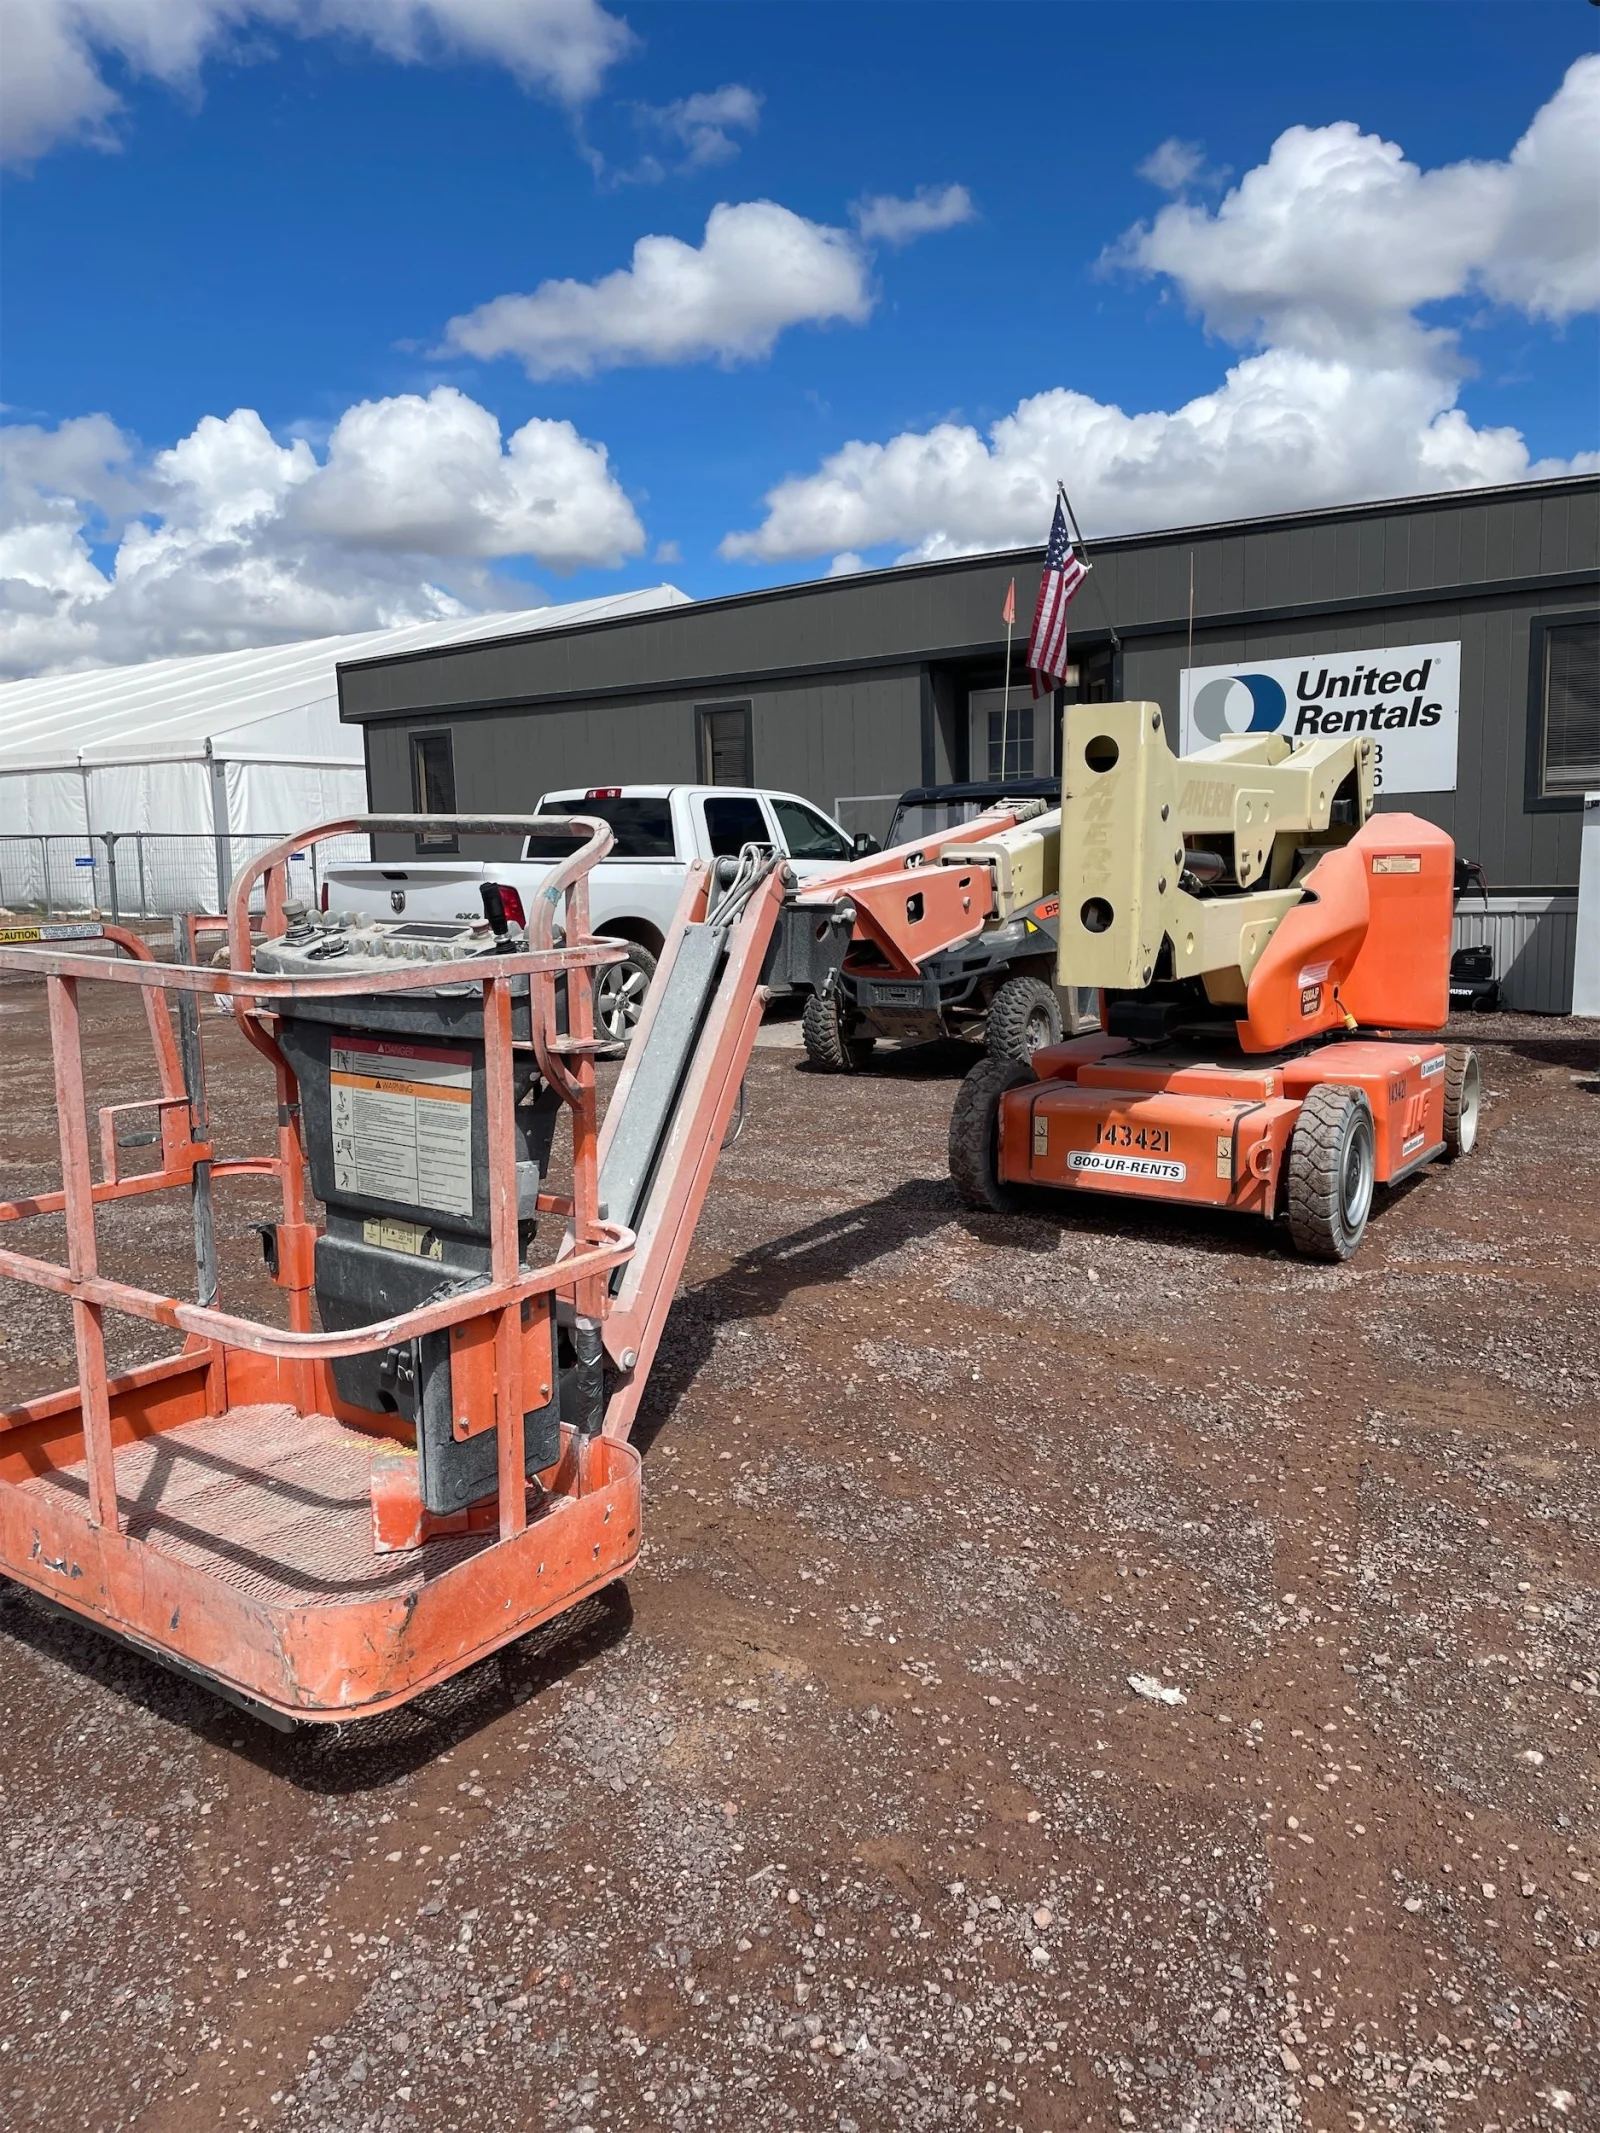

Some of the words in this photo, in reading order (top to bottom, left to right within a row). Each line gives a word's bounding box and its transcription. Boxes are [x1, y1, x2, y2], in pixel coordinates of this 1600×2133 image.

[1296, 659, 1433, 701] United
[1294, 696, 1443, 736] Rentals
[385, 1044, 414, 1057] DANGER
[382, 1080, 414, 1093] WARNING
[1096, 1122, 1171, 1153] 143421
[1073, 1155, 1180, 1178] 800-UR-RENTS
